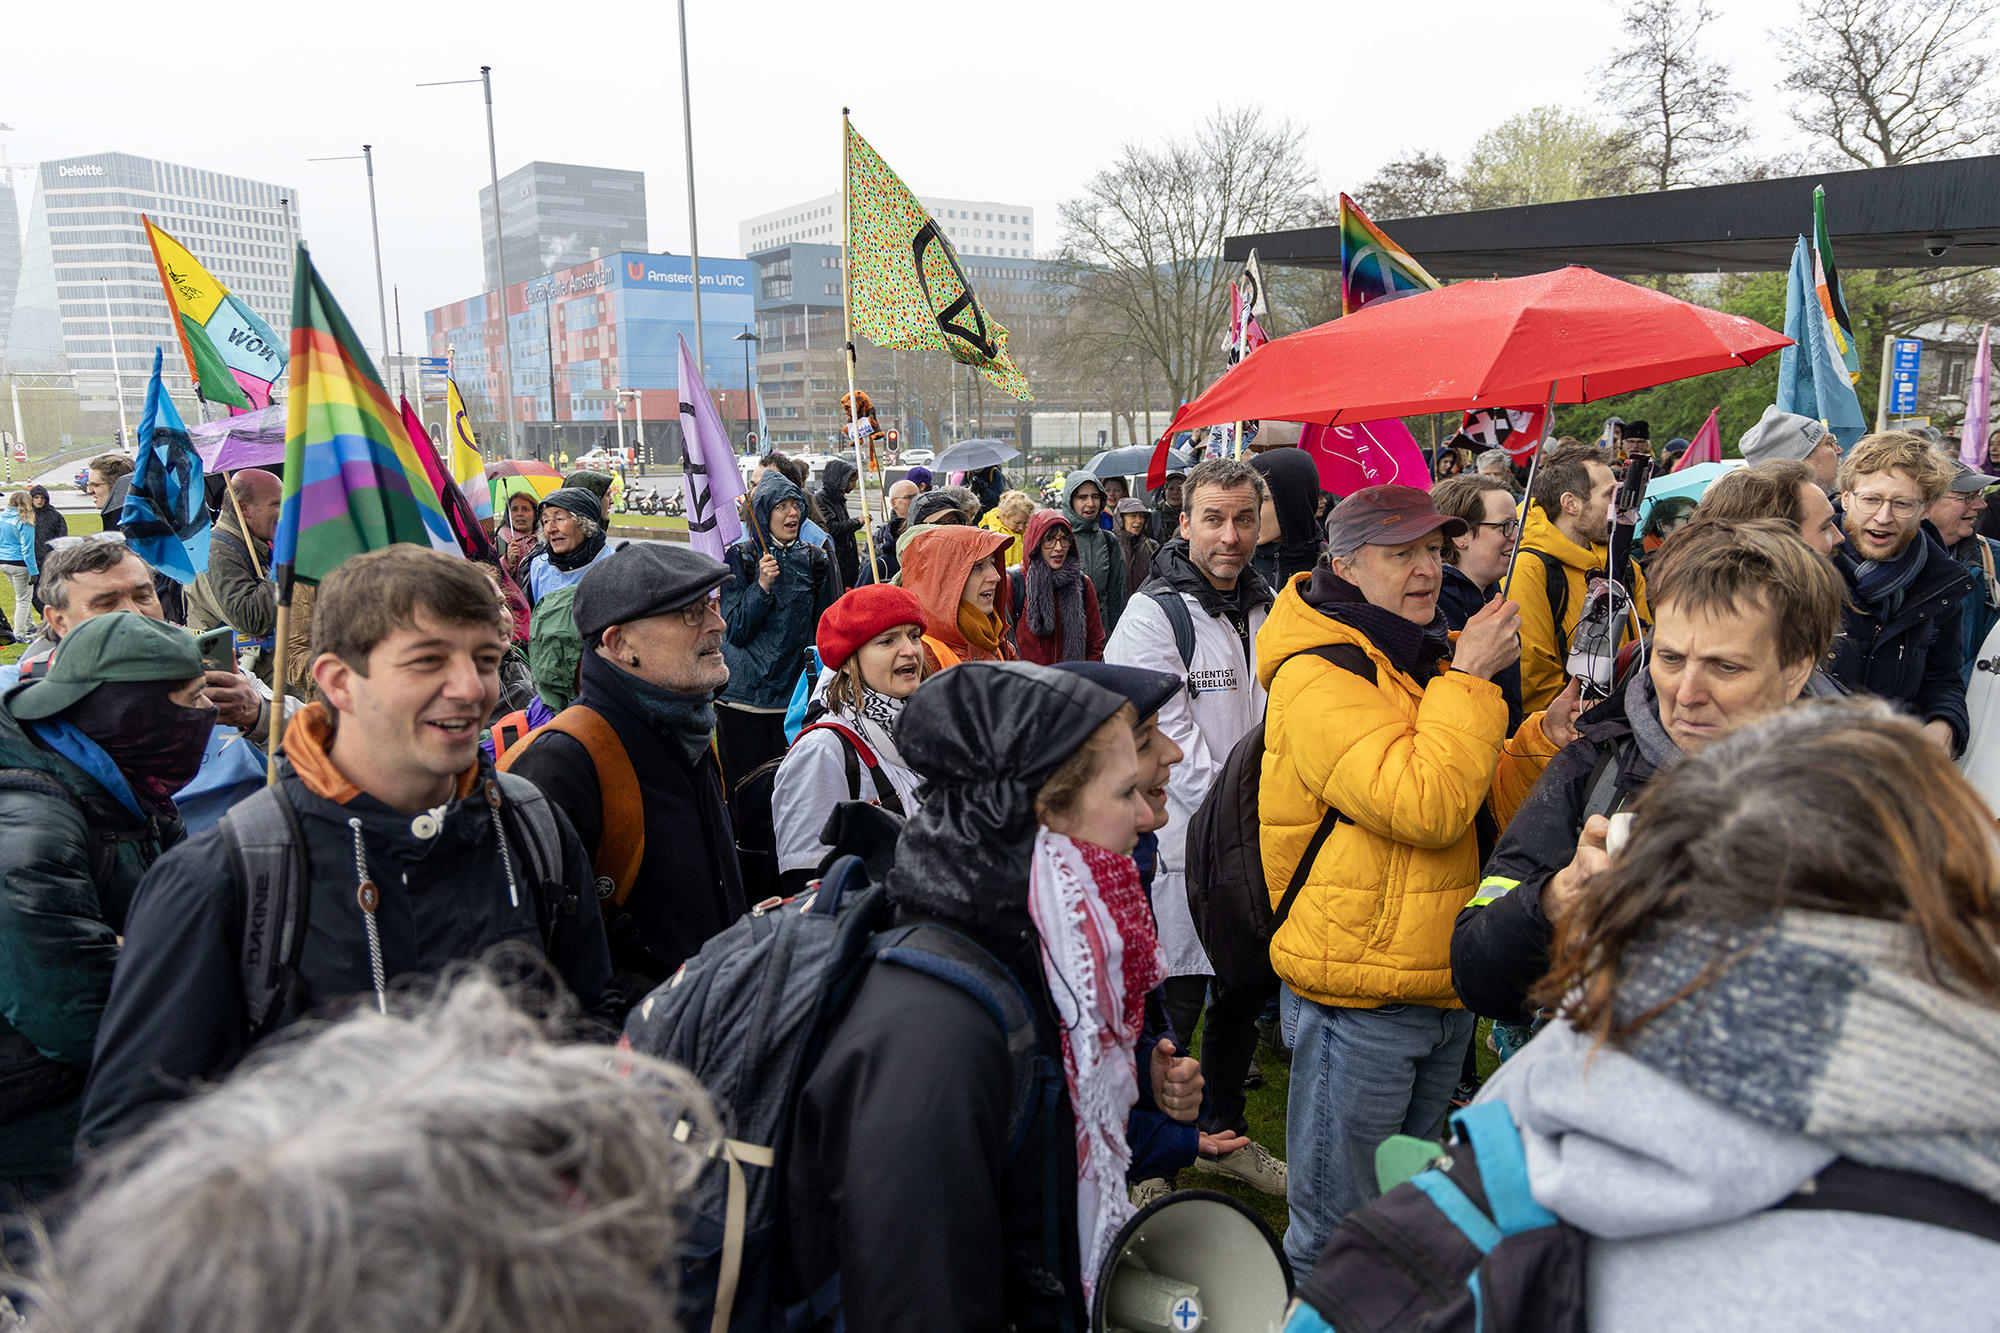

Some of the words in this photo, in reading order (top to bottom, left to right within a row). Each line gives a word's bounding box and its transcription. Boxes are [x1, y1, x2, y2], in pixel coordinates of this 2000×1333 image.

[546, 279, 570, 299] Center
[570, 266, 615, 294] Amsterdam
[715, 274, 745, 287] UMC
[1190, 669, 1234, 680] SCIENTIST
[247, 871, 269, 966] DAKINE
